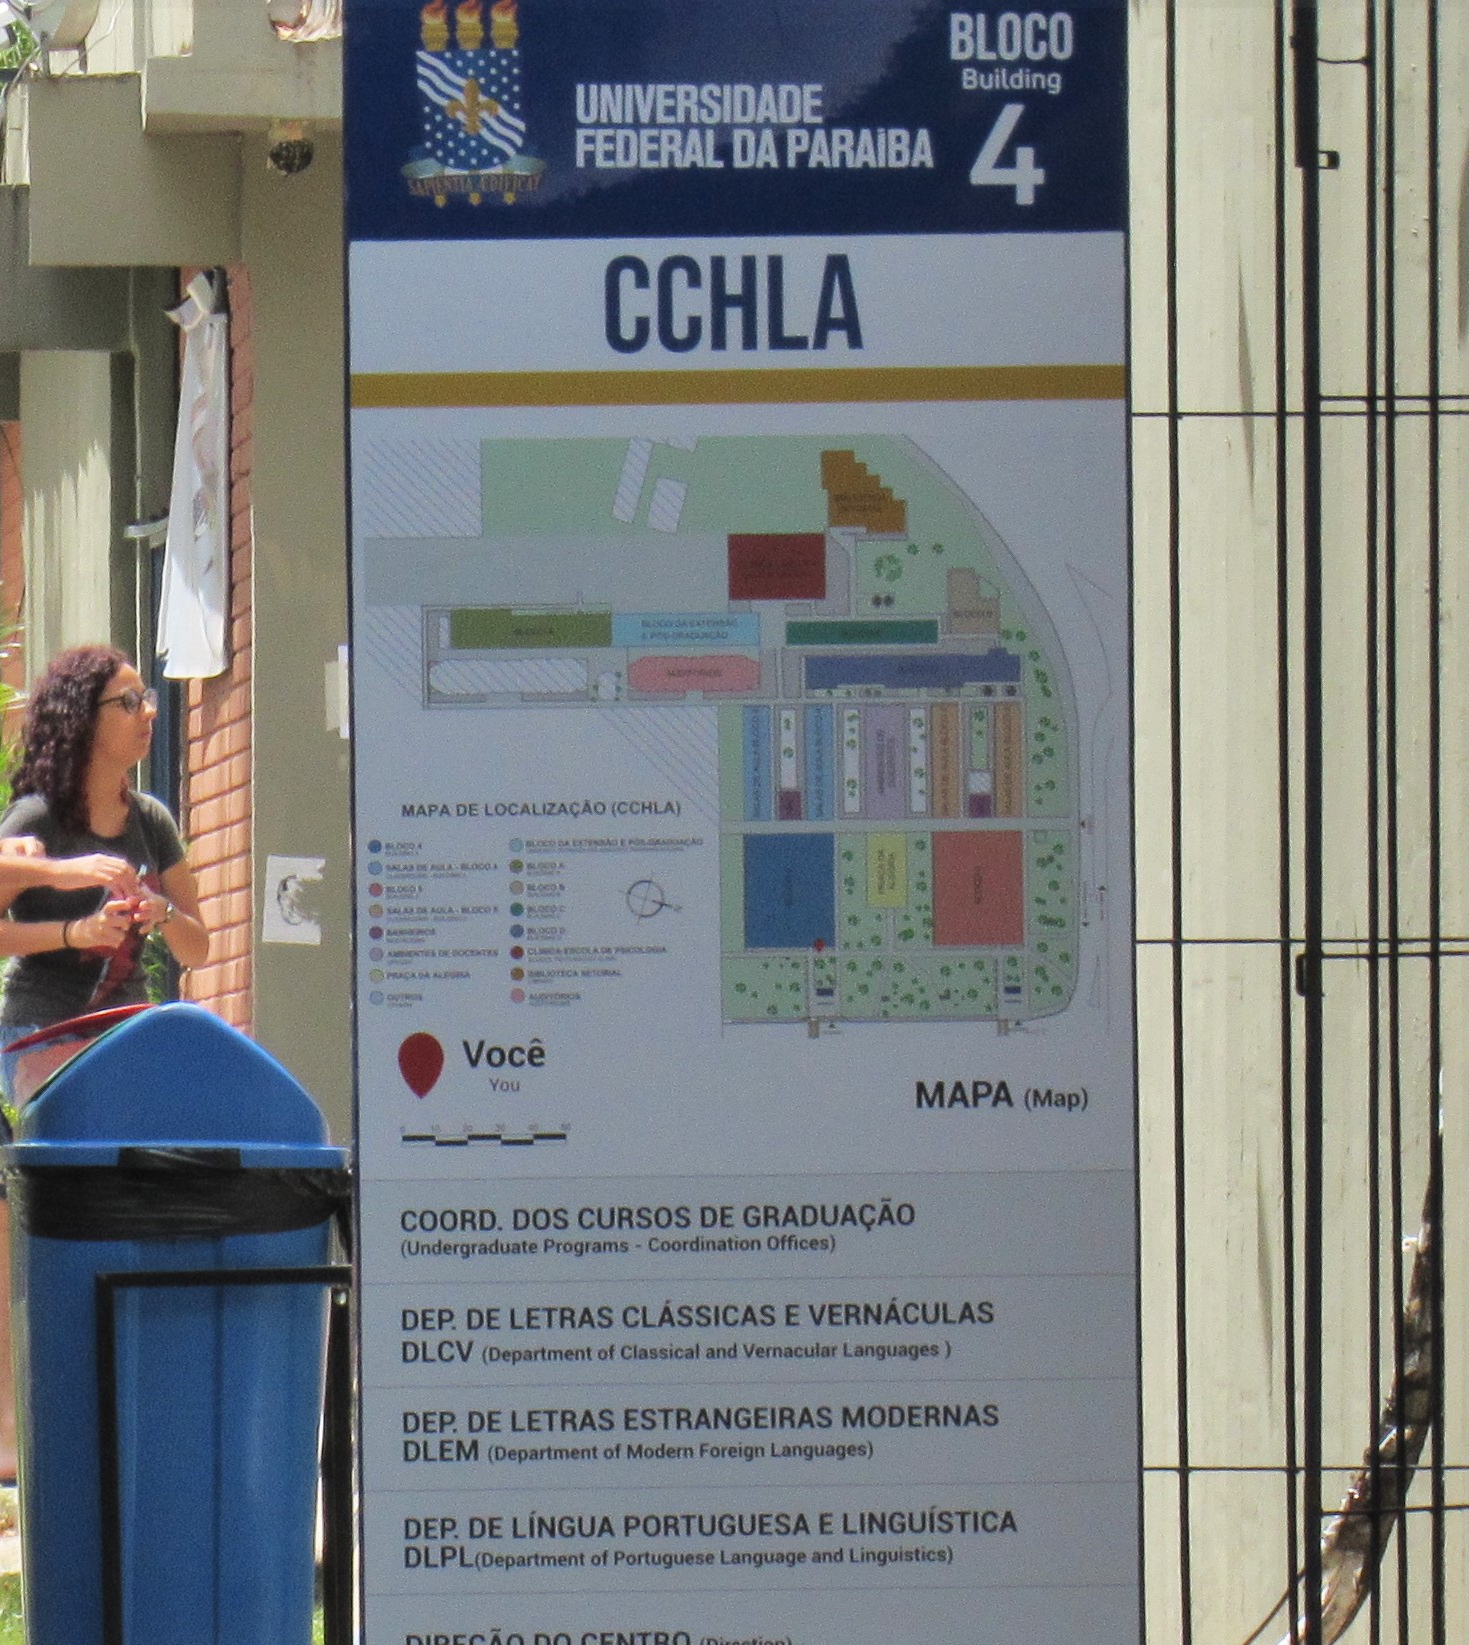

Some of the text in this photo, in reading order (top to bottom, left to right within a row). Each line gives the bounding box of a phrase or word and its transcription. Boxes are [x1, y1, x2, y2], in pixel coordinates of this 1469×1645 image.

[950, 11, 1074, 62] BLOCO
[961, 66, 1062, 96] Building
[576, 82, 823, 126] UNIVERSIDADE
[575, 126, 725, 170] FEDERAL
[731, 127, 779, 170] DA
[969, 102, 1045, 206] 4
[604, 252, 864, 354] CCHLA
[401, 800, 682, 820] MAPA DE LOCALIZAÇÃO (CCHLA)
[462, 1037, 546, 1069] Você
[488, 1077, 521, 1093] You
[916, 1079, 1089, 1113] MAPA (Map)
[400, 1199, 916, 1233] COORD. DOS CURSOS DE GRADUAÇÃO
[400, 1238, 539, 1260] (Undergraduate
[543, 1237, 629, 1258] Programs
[647, 1234, 762, 1254] Coordination
[766, 1233, 837, 1254] Offices)
[401, 1299, 995, 1332] DEP. DE LETRAS CLÁSSICAS E VERNÁCULAS
[401, 1339, 474, 1365] DLCV
[481, 1345, 593, 1366] (Department
[597, 1343, 615, 1362] of
[620, 1341, 701, 1362] Classical
[705, 1341, 738, 1360] and
[742, 1341, 838, 1360] Vernacular
[842, 1342, 940, 1363] Languages
[402, 1403, 1000, 1435] DEP. DE LETRAS ESTRANGEIRAS MODERNAS
[403, 1438, 874, 1465] DLEM (Department of Modern Foreign Languages)
[404, 1509, 1018, 1541] DEP. DE LÍNGUA PORTUGUESA E LINGUÍSTICA
[590, 1549, 609, 1567] of
[613, 1550, 715, 1570] Portuguese
[720, 1549, 807, 1569] Language
[811, 1547, 845, 1565] and
[849, 1545, 954, 1568] Linguistics)
